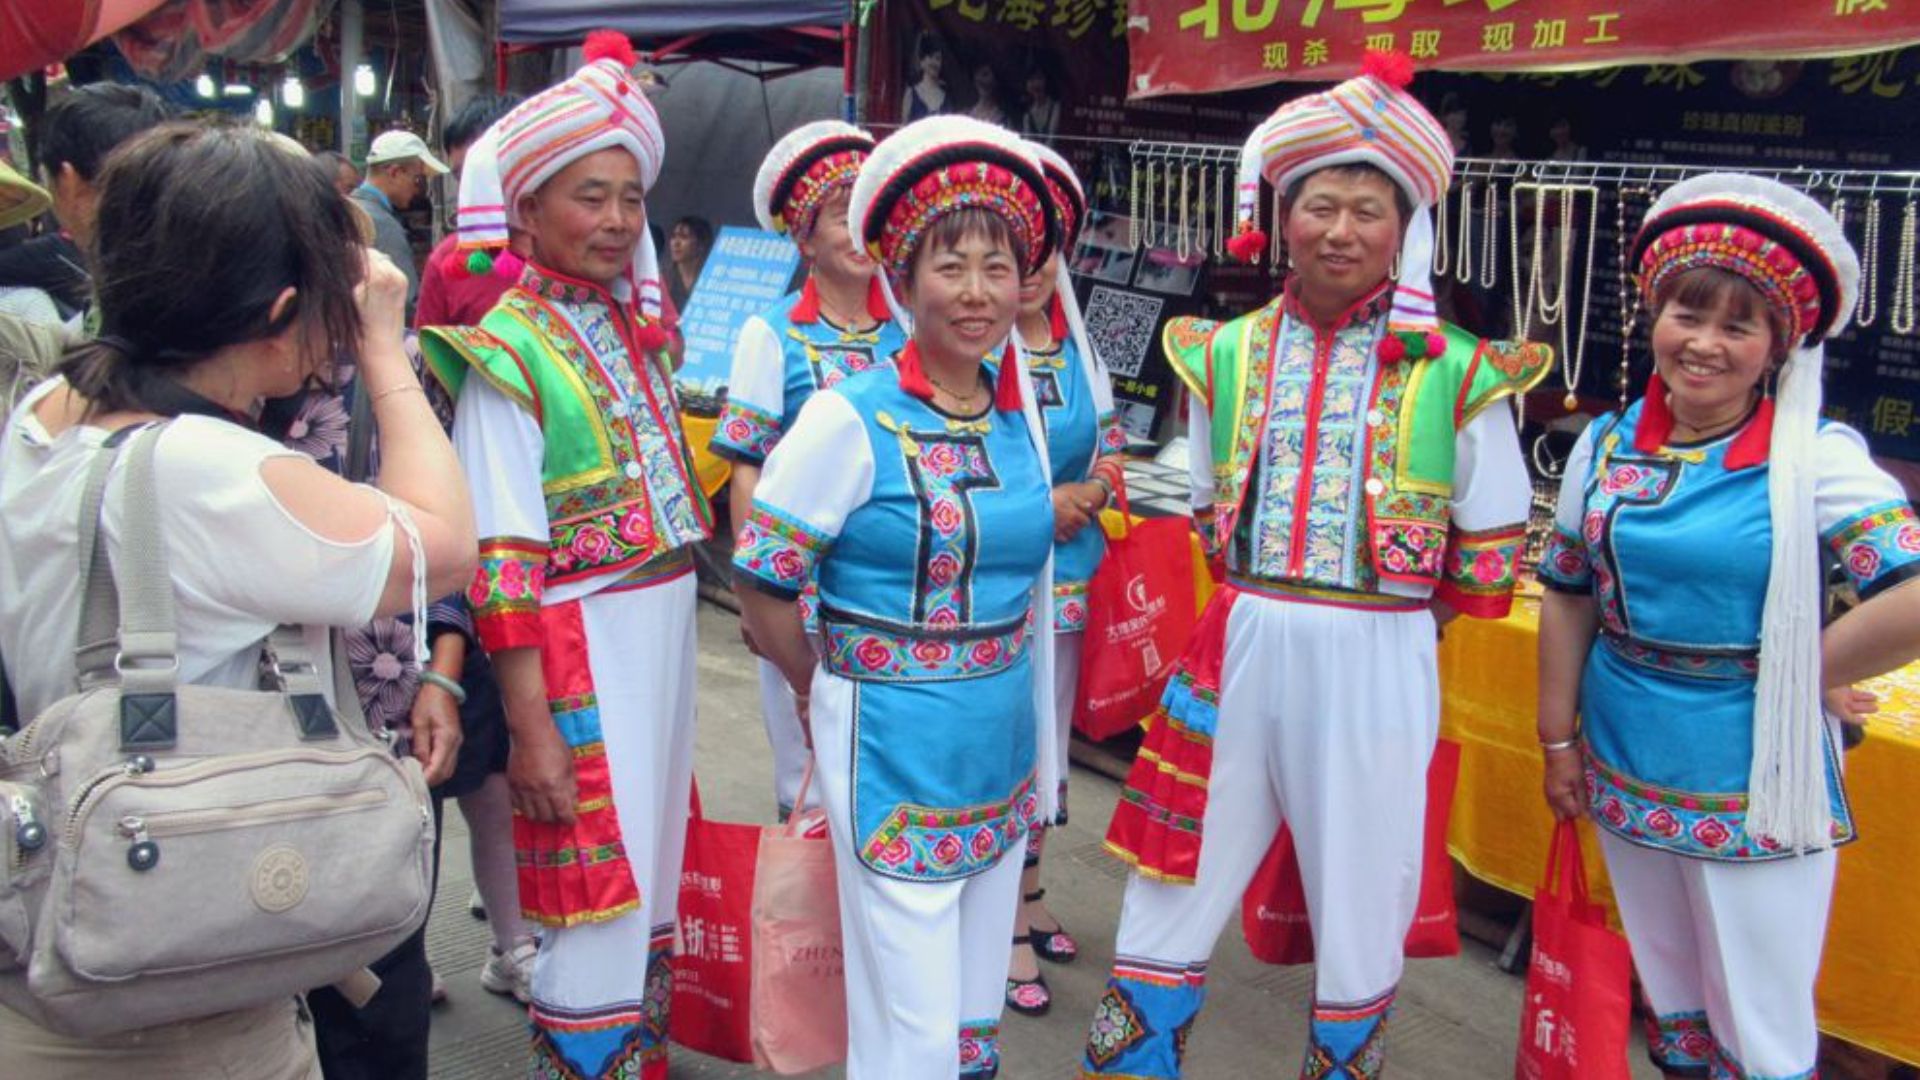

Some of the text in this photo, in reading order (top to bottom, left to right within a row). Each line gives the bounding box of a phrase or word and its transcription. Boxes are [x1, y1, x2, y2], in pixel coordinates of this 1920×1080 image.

[1262, 39, 1330, 68] 现杀
[1480, 14, 1620, 51] 现加工
[1828, 50, 1920, 98] 现
[1872, 397, 1920, 437] 假
